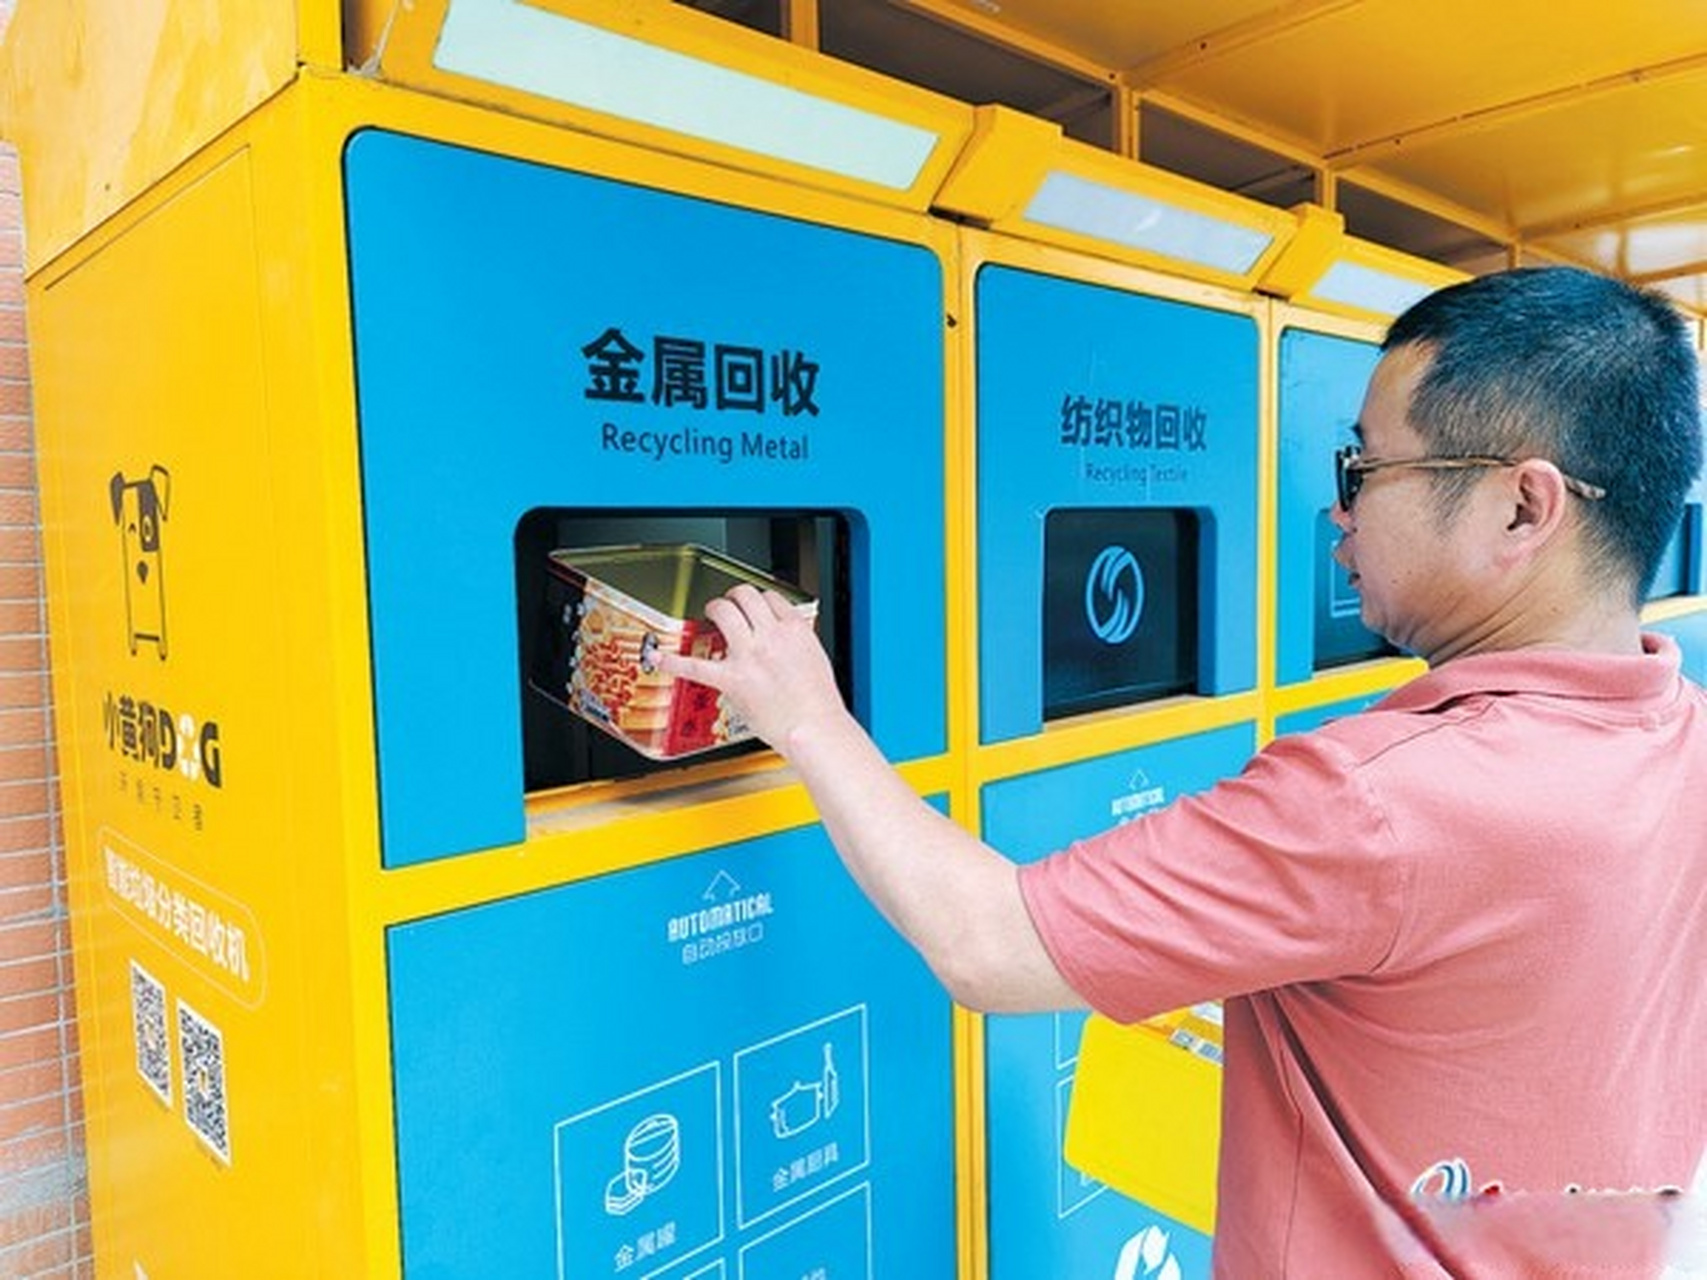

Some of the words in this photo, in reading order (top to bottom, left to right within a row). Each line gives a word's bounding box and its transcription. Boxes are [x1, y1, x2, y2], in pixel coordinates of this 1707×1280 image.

[581, 327, 820, 418] 金属回收
[602, 422, 733, 464] Recycling
[741, 431, 809, 461] Metal
[1061, 394, 1207, 450] 纺织物回收
[1086, 462, 1148, 487] Recycling
